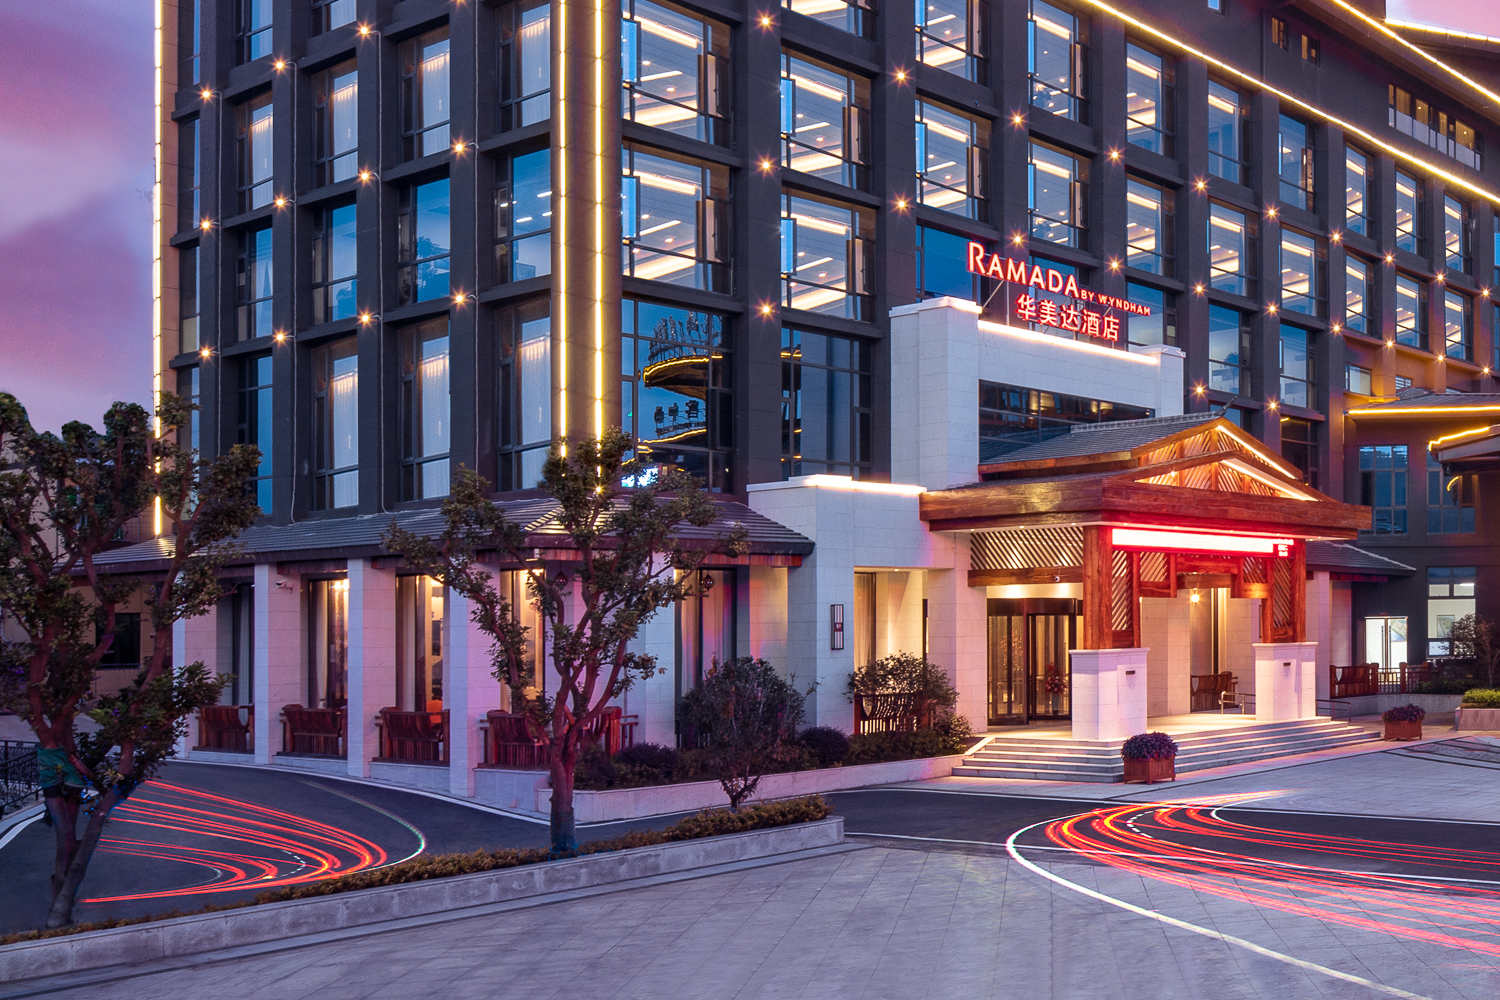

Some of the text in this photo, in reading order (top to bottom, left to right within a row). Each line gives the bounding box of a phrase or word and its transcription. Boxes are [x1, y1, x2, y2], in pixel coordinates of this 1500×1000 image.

[1016, 294, 1119, 341] 华美达酒店
[1081, 289, 1095, 301] BY
[1098, 294, 1150, 316] WYNDHAM
